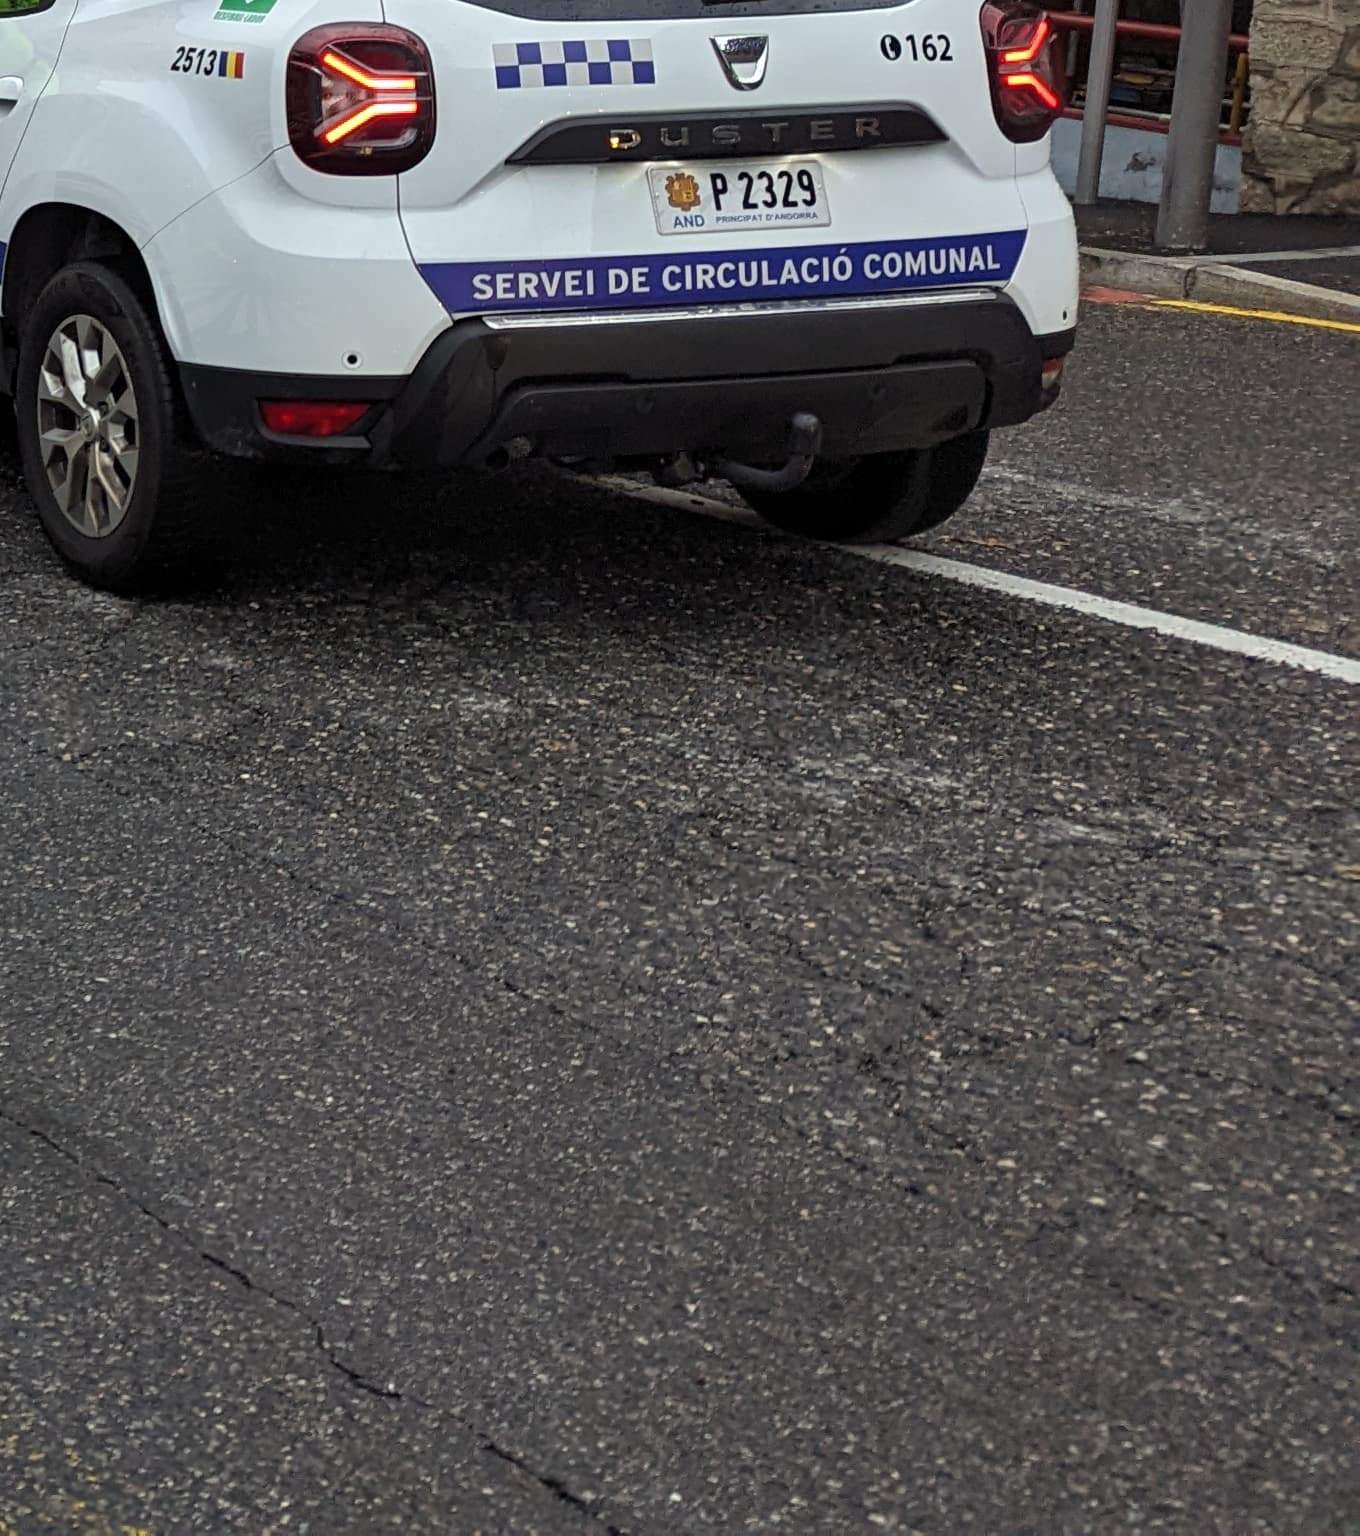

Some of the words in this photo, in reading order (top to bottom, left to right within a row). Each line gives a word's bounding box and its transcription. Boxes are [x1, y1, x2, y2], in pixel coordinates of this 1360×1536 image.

[171, 46, 218, 76] 2513
[905, 34, 954, 61] 162
[608, 117, 881, 150] DUSTER
[710, 172, 728, 212] P
[737, 169, 818, 211] 2329
[673, 214, 705, 228] AND
[716, 214, 764, 224] PRINCIPAT
[765, 211, 818, 223] D'ANDORRA
[471, 270, 595, 301] SERVEI
[608, 267, 650, 295] DE
[662, 248, 853, 292] CIRCULACIÓ
[862, 244, 1001, 280] COMUNAL
